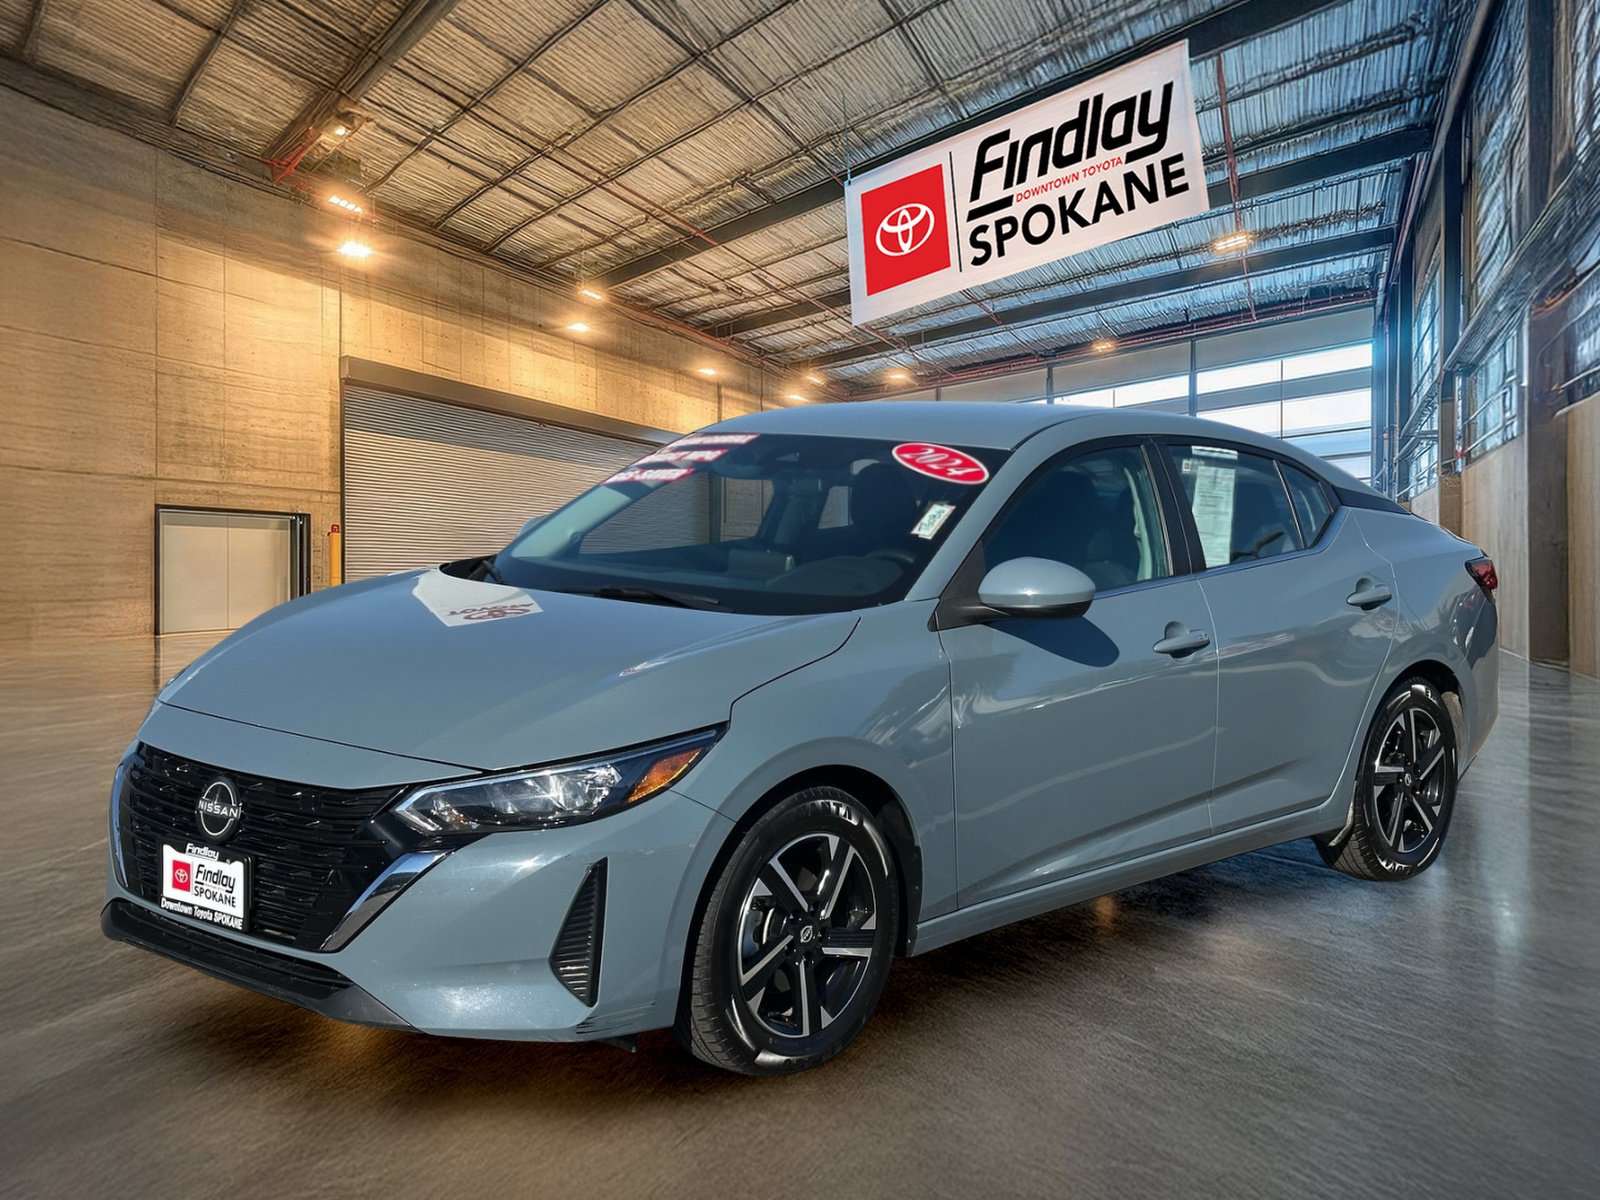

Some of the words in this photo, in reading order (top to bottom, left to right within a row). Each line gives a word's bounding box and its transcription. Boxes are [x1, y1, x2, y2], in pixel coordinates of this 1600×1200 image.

[968, 80, 1174, 202] Findlay
[1015, 173, 1080, 203] DOWNTOWN
[1081, 156, 1124, 178] TOYOTA
[968, 152, 1190, 267] SPOKANE
[900, 448, 982, 475] 2024
[198, 799, 239, 818] NISSAN
[185, 843, 219, 861] Findlay
[194, 864, 236, 894] Findlay
[193, 885, 236, 908] SPOKANE
[160, 897, 194, 916] Downtown
[194, 905, 214, 921] Toyota
[213, 911, 243, 931] SPOKANE
